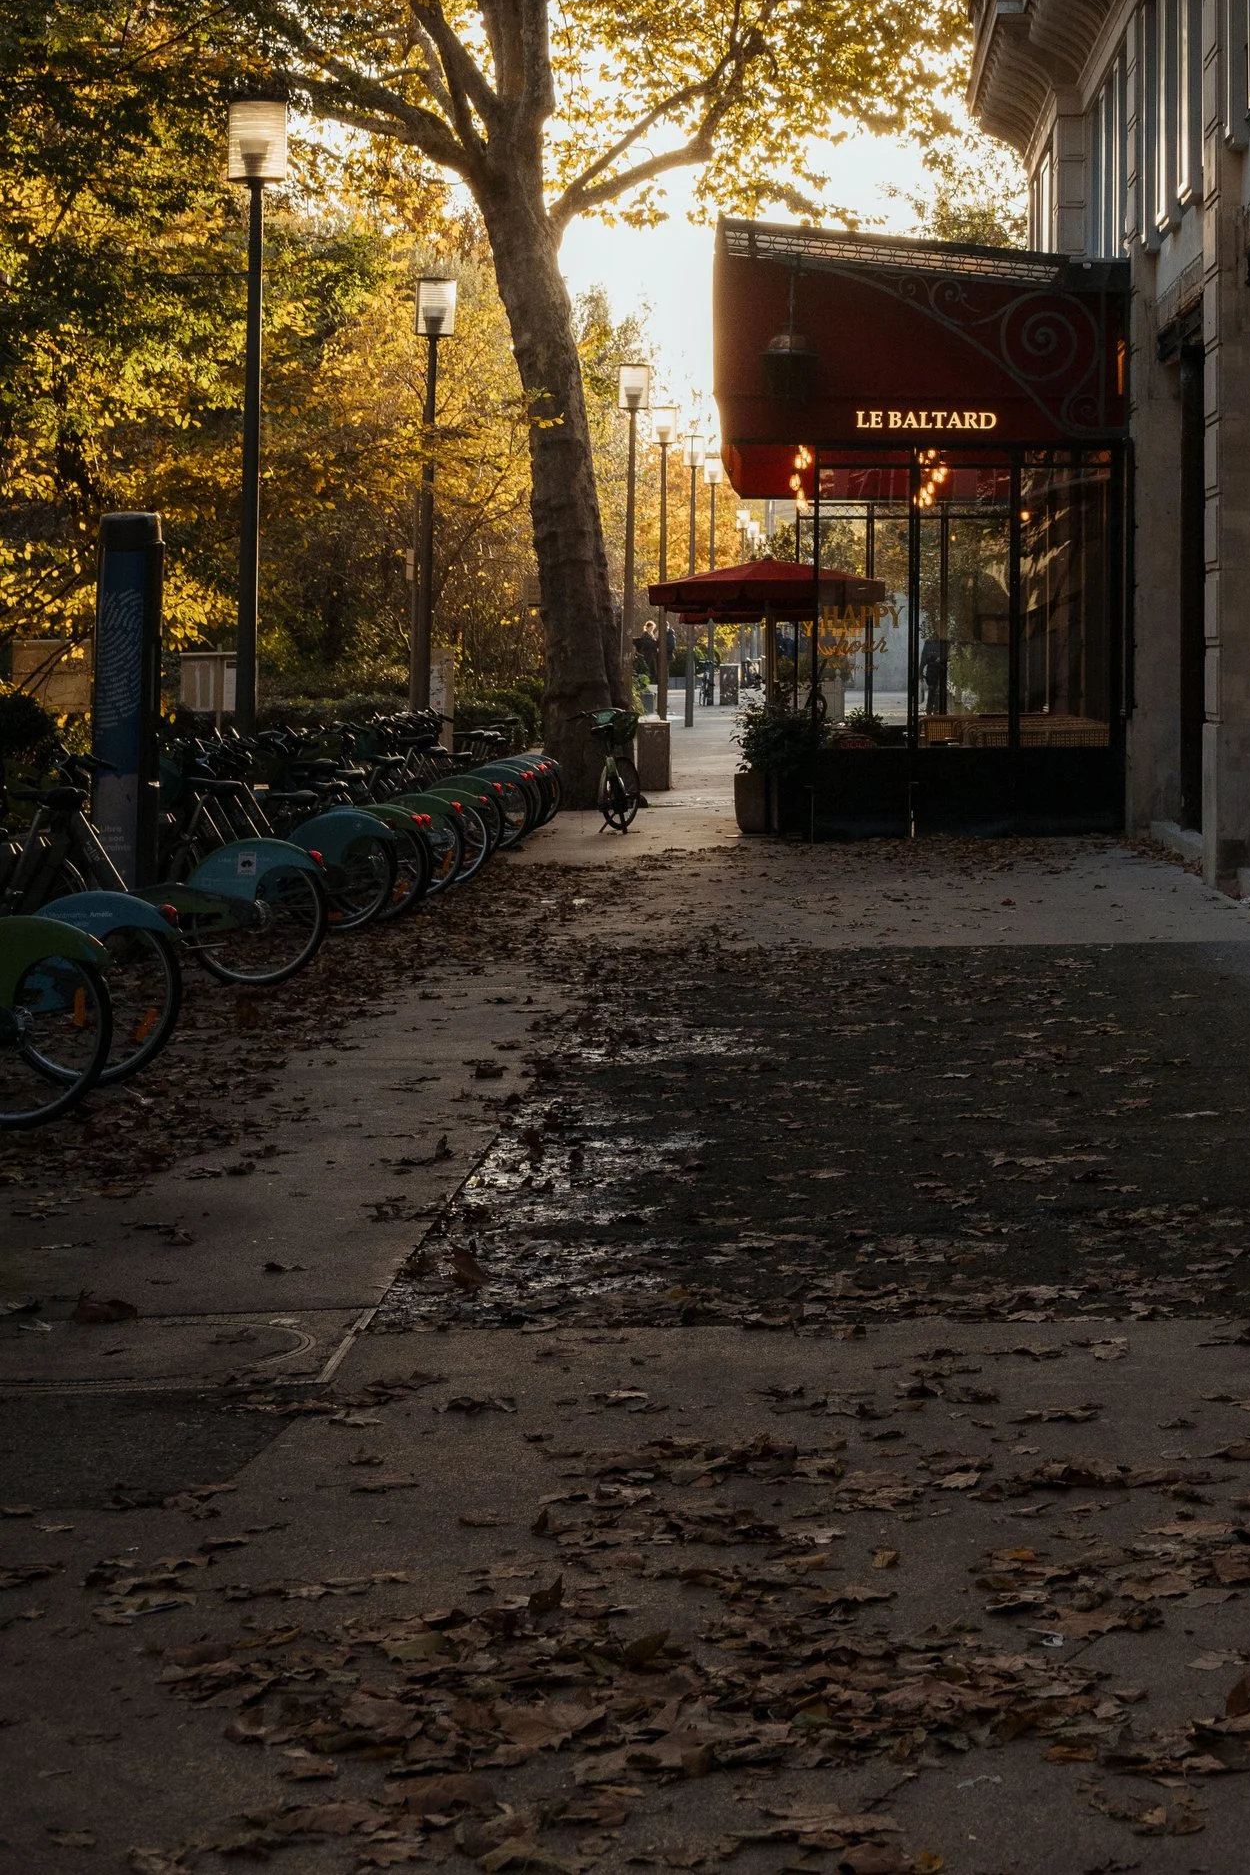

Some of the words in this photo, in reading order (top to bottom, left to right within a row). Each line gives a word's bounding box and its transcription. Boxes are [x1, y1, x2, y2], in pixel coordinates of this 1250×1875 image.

[855, 409, 883, 429] LE
[887, 409, 997, 429] BALTARD
[822, 603, 905, 629] HAPPY
